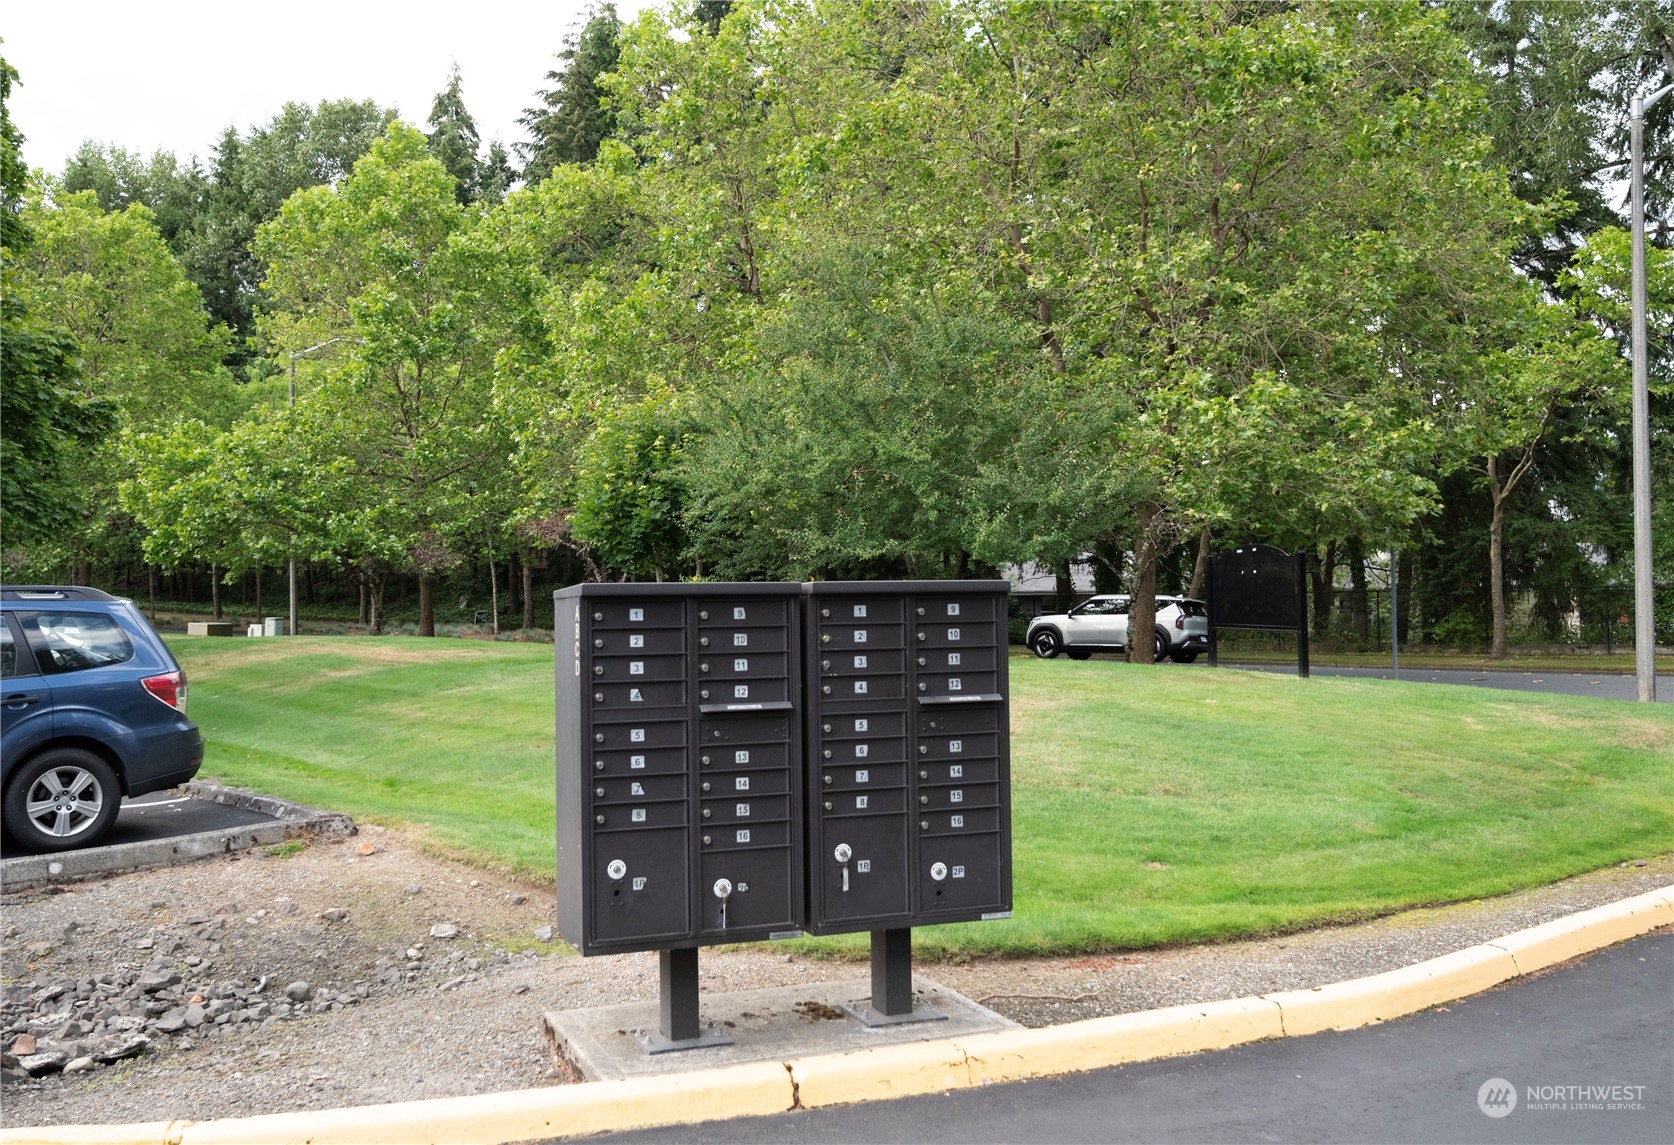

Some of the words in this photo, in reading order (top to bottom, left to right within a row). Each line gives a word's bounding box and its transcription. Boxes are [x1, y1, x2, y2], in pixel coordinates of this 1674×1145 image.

[949, 630, 959, 638] 10
[735, 635, 746, 644] 10
[950, 655, 958, 663] 11
[736, 661, 745, 669] 11
[950, 679, 960, 688] 12
[736, 687, 747, 696] 12
[951, 742, 961, 750] 13
[737, 752, 747, 762] 13
[952, 767, 961, 775] 14
[737, 779, 747, 788] 14
[952, 791, 962, 800] 15
[738, 805, 748, 814] 15
[953, 816, 962, 825] 16
[738, 831, 748, 840] 16
[859, 861, 869, 871] 1P
[953, 867, 964, 876] 2P
